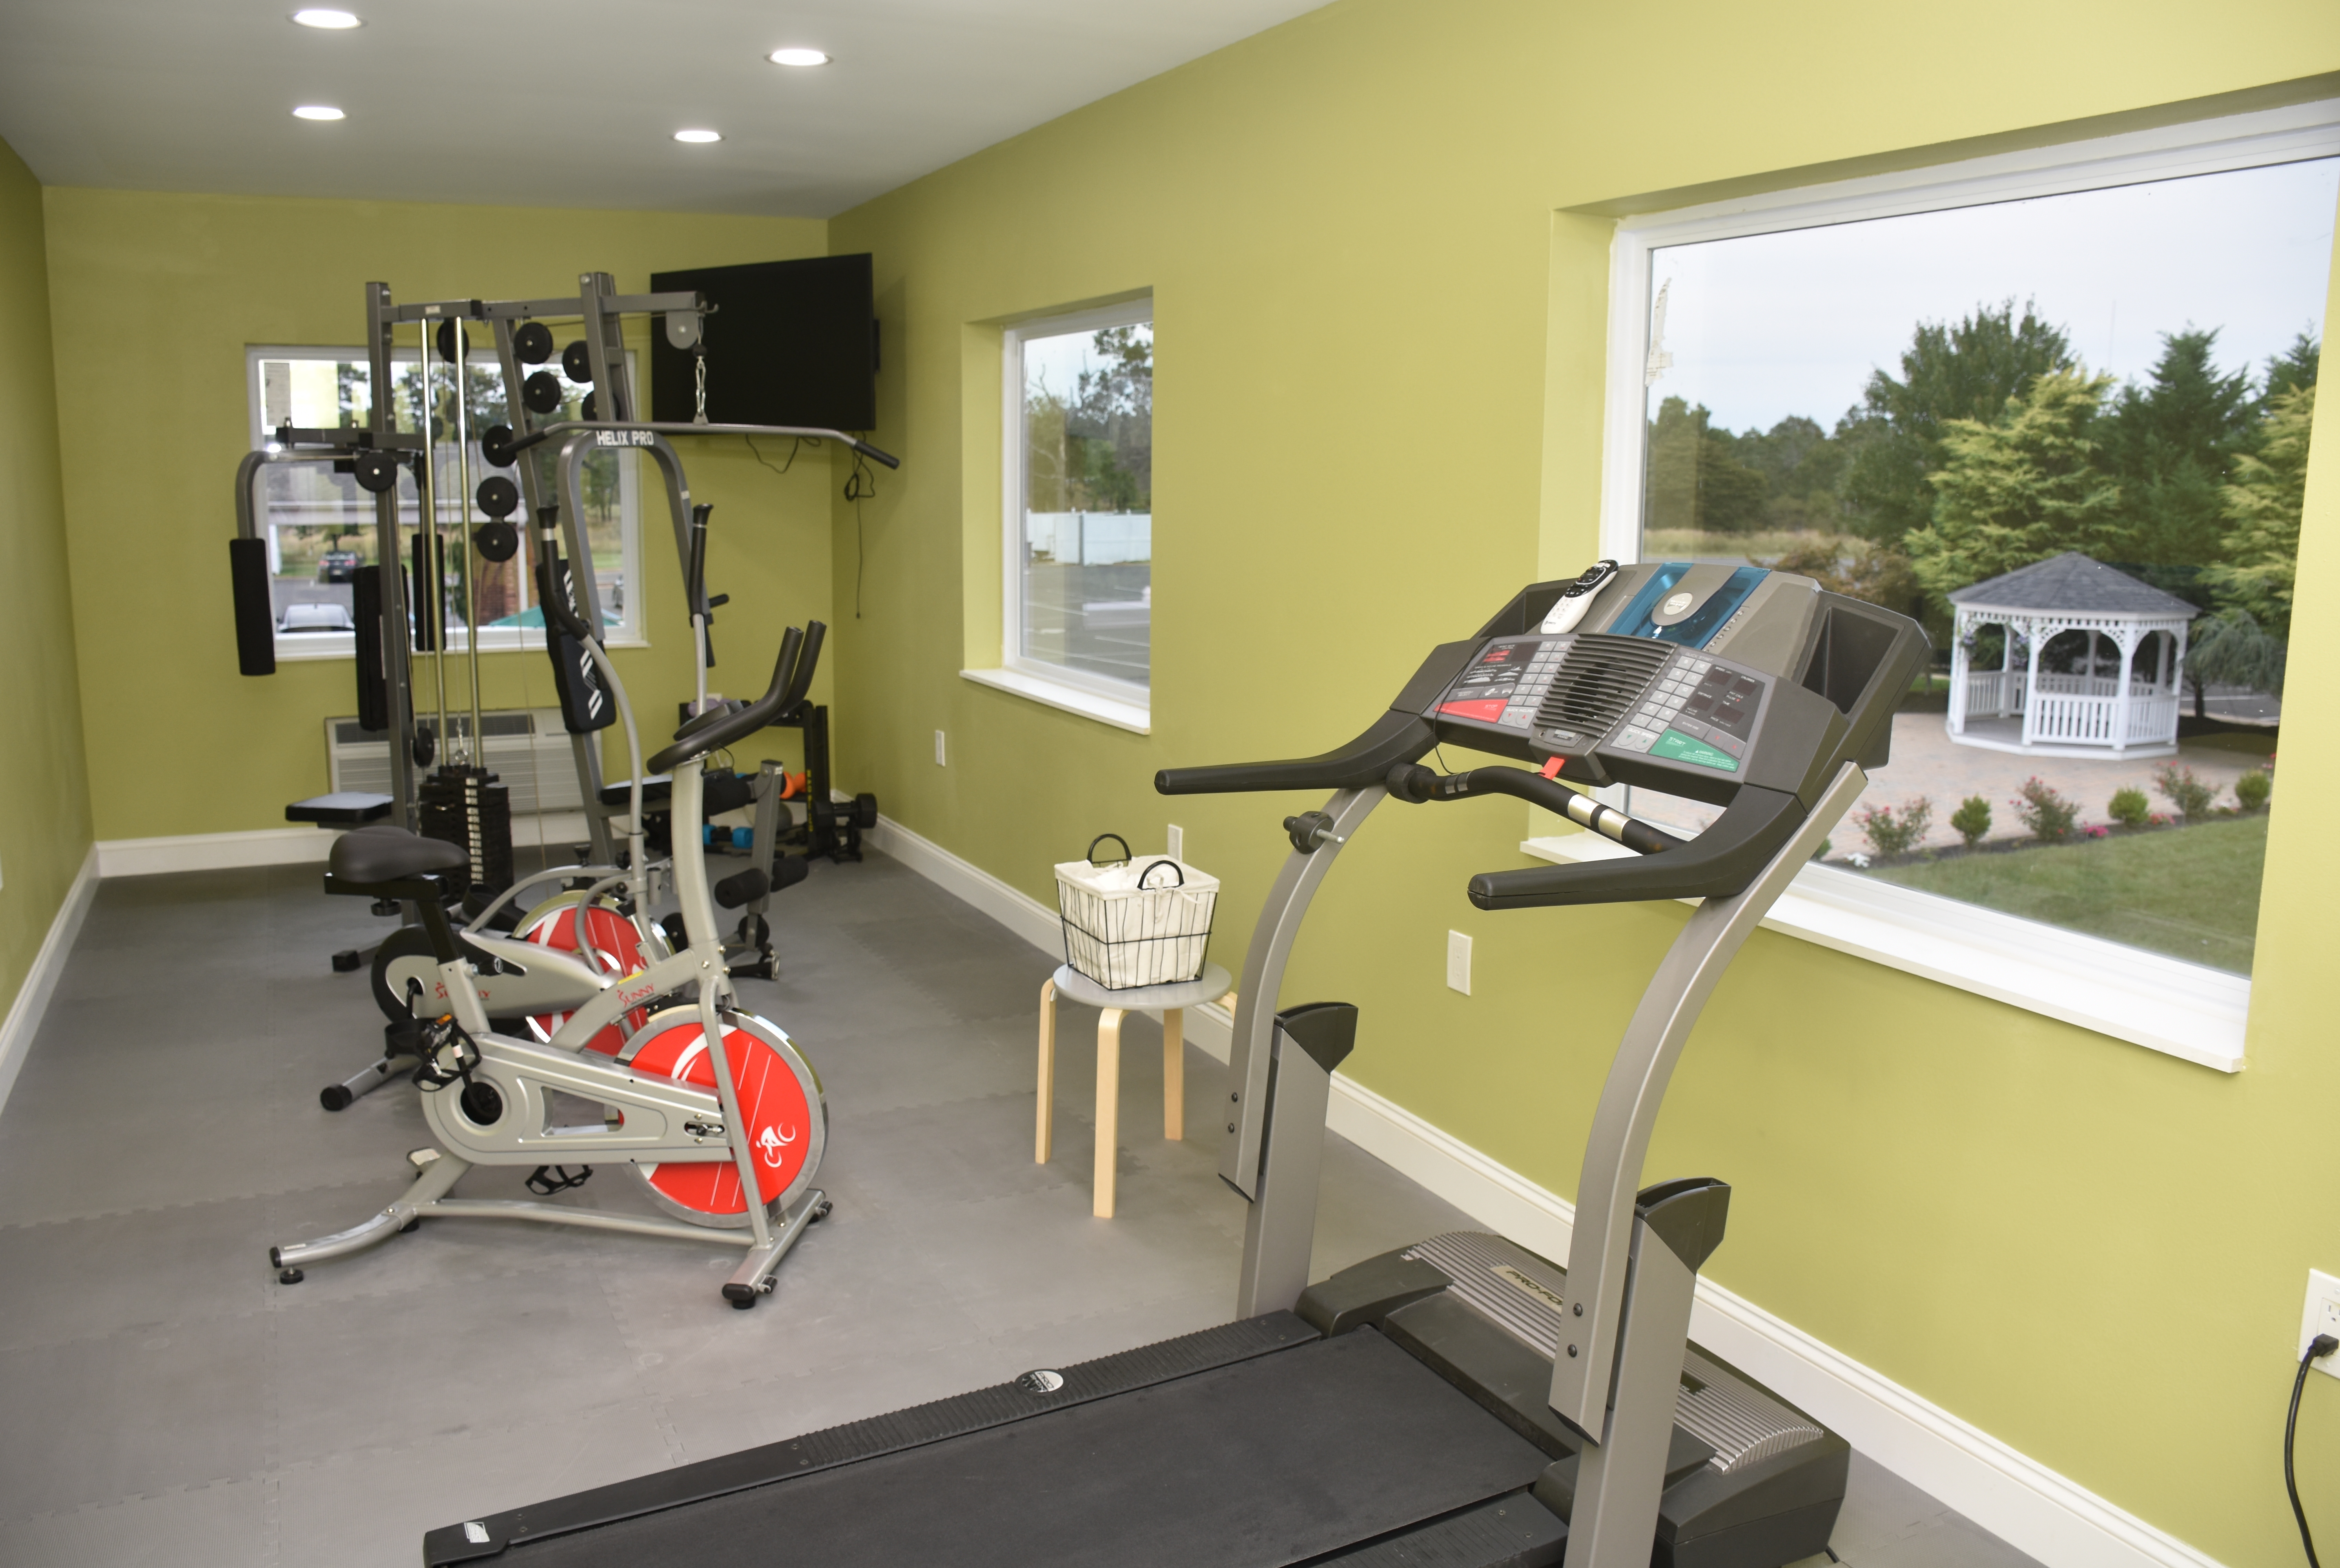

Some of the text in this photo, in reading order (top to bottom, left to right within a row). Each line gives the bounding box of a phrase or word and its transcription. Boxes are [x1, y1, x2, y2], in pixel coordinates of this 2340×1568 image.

[596, 430, 654, 446] HELIX PRO
[1668, 737, 1686, 746] START
[617, 983, 654, 1008] SUNNY
[1506, 1271, 1563, 1305] PRO-FO
[1037, 1372, 1054, 1389] PRO
